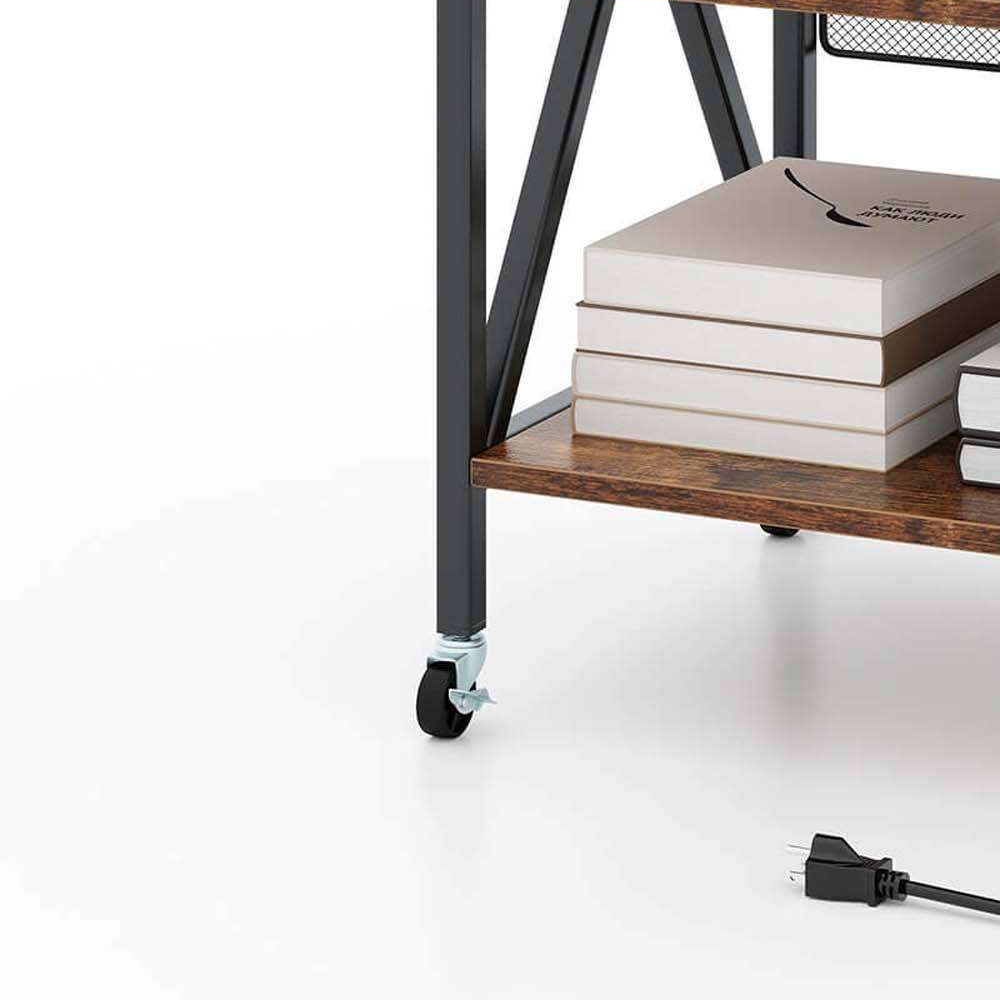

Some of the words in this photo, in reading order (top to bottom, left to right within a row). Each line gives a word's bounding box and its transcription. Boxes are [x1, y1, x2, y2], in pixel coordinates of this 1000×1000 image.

[856, 211, 939, 223] ДУМАЮТ
[869, 205, 905, 213] КАК
[907, 208, 966, 219] ЛЮДИ
